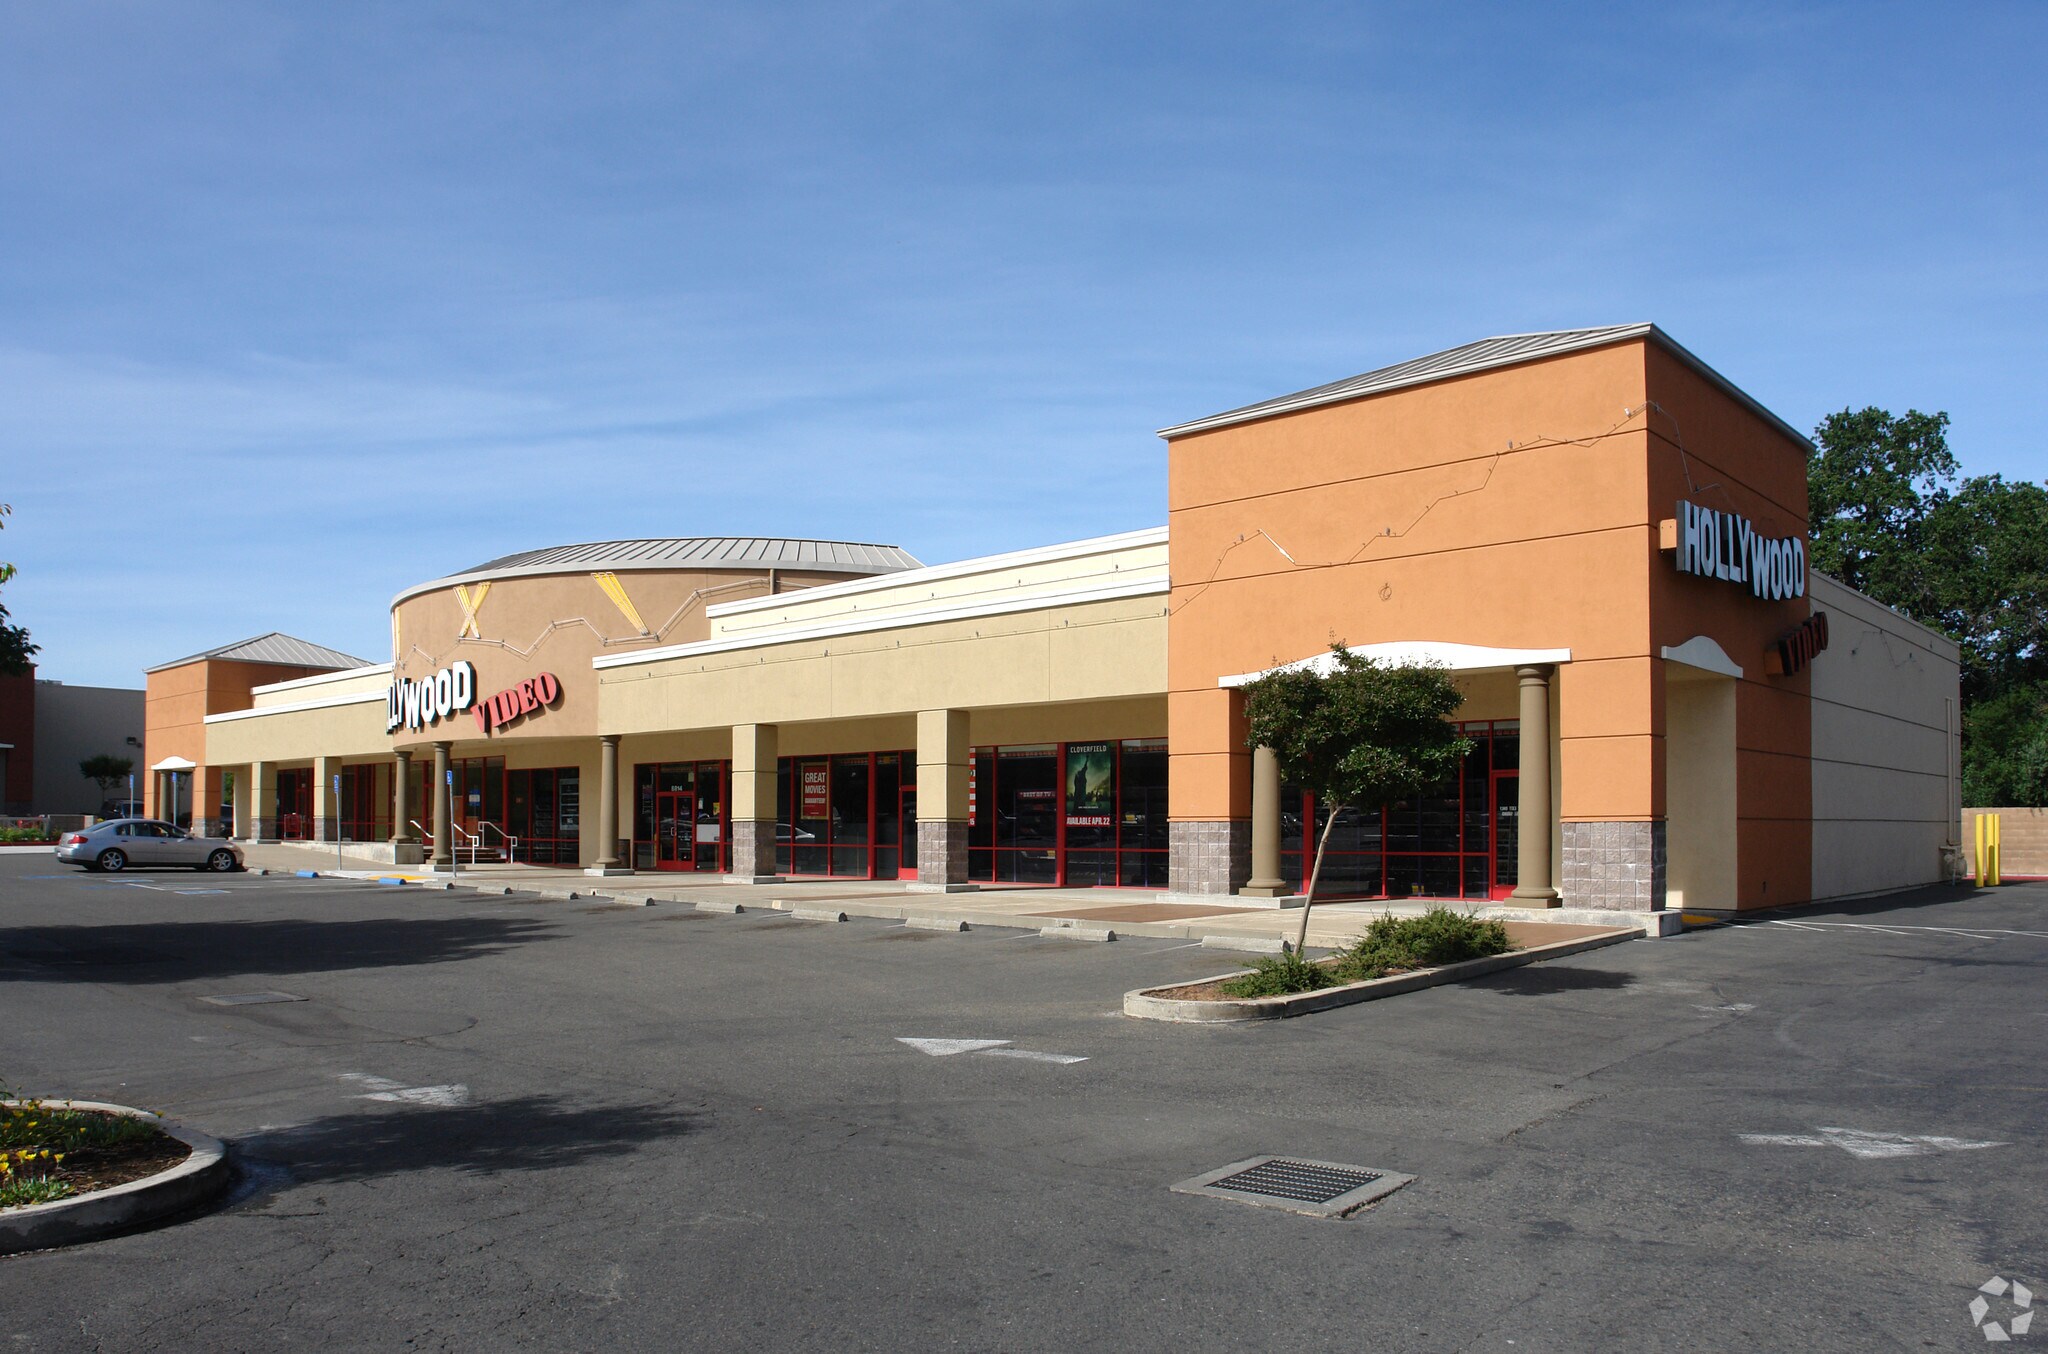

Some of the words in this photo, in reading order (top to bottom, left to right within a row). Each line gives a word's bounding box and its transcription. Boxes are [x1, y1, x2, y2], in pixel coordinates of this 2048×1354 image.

[1679, 500, 1805, 601] HOLLYWOOD
[1780, 611, 1829, 676] VIDEO
[470, 671, 557, 734] VIDEO
[1070, 745, 1107, 753] CLOVERFIELD
[804, 772, 826, 783] GREAT
[804, 785, 826, 794] MOVIES
[1066, 817, 1091, 825] AVAILABLE
[1103, 816, 1110, 825] 22
